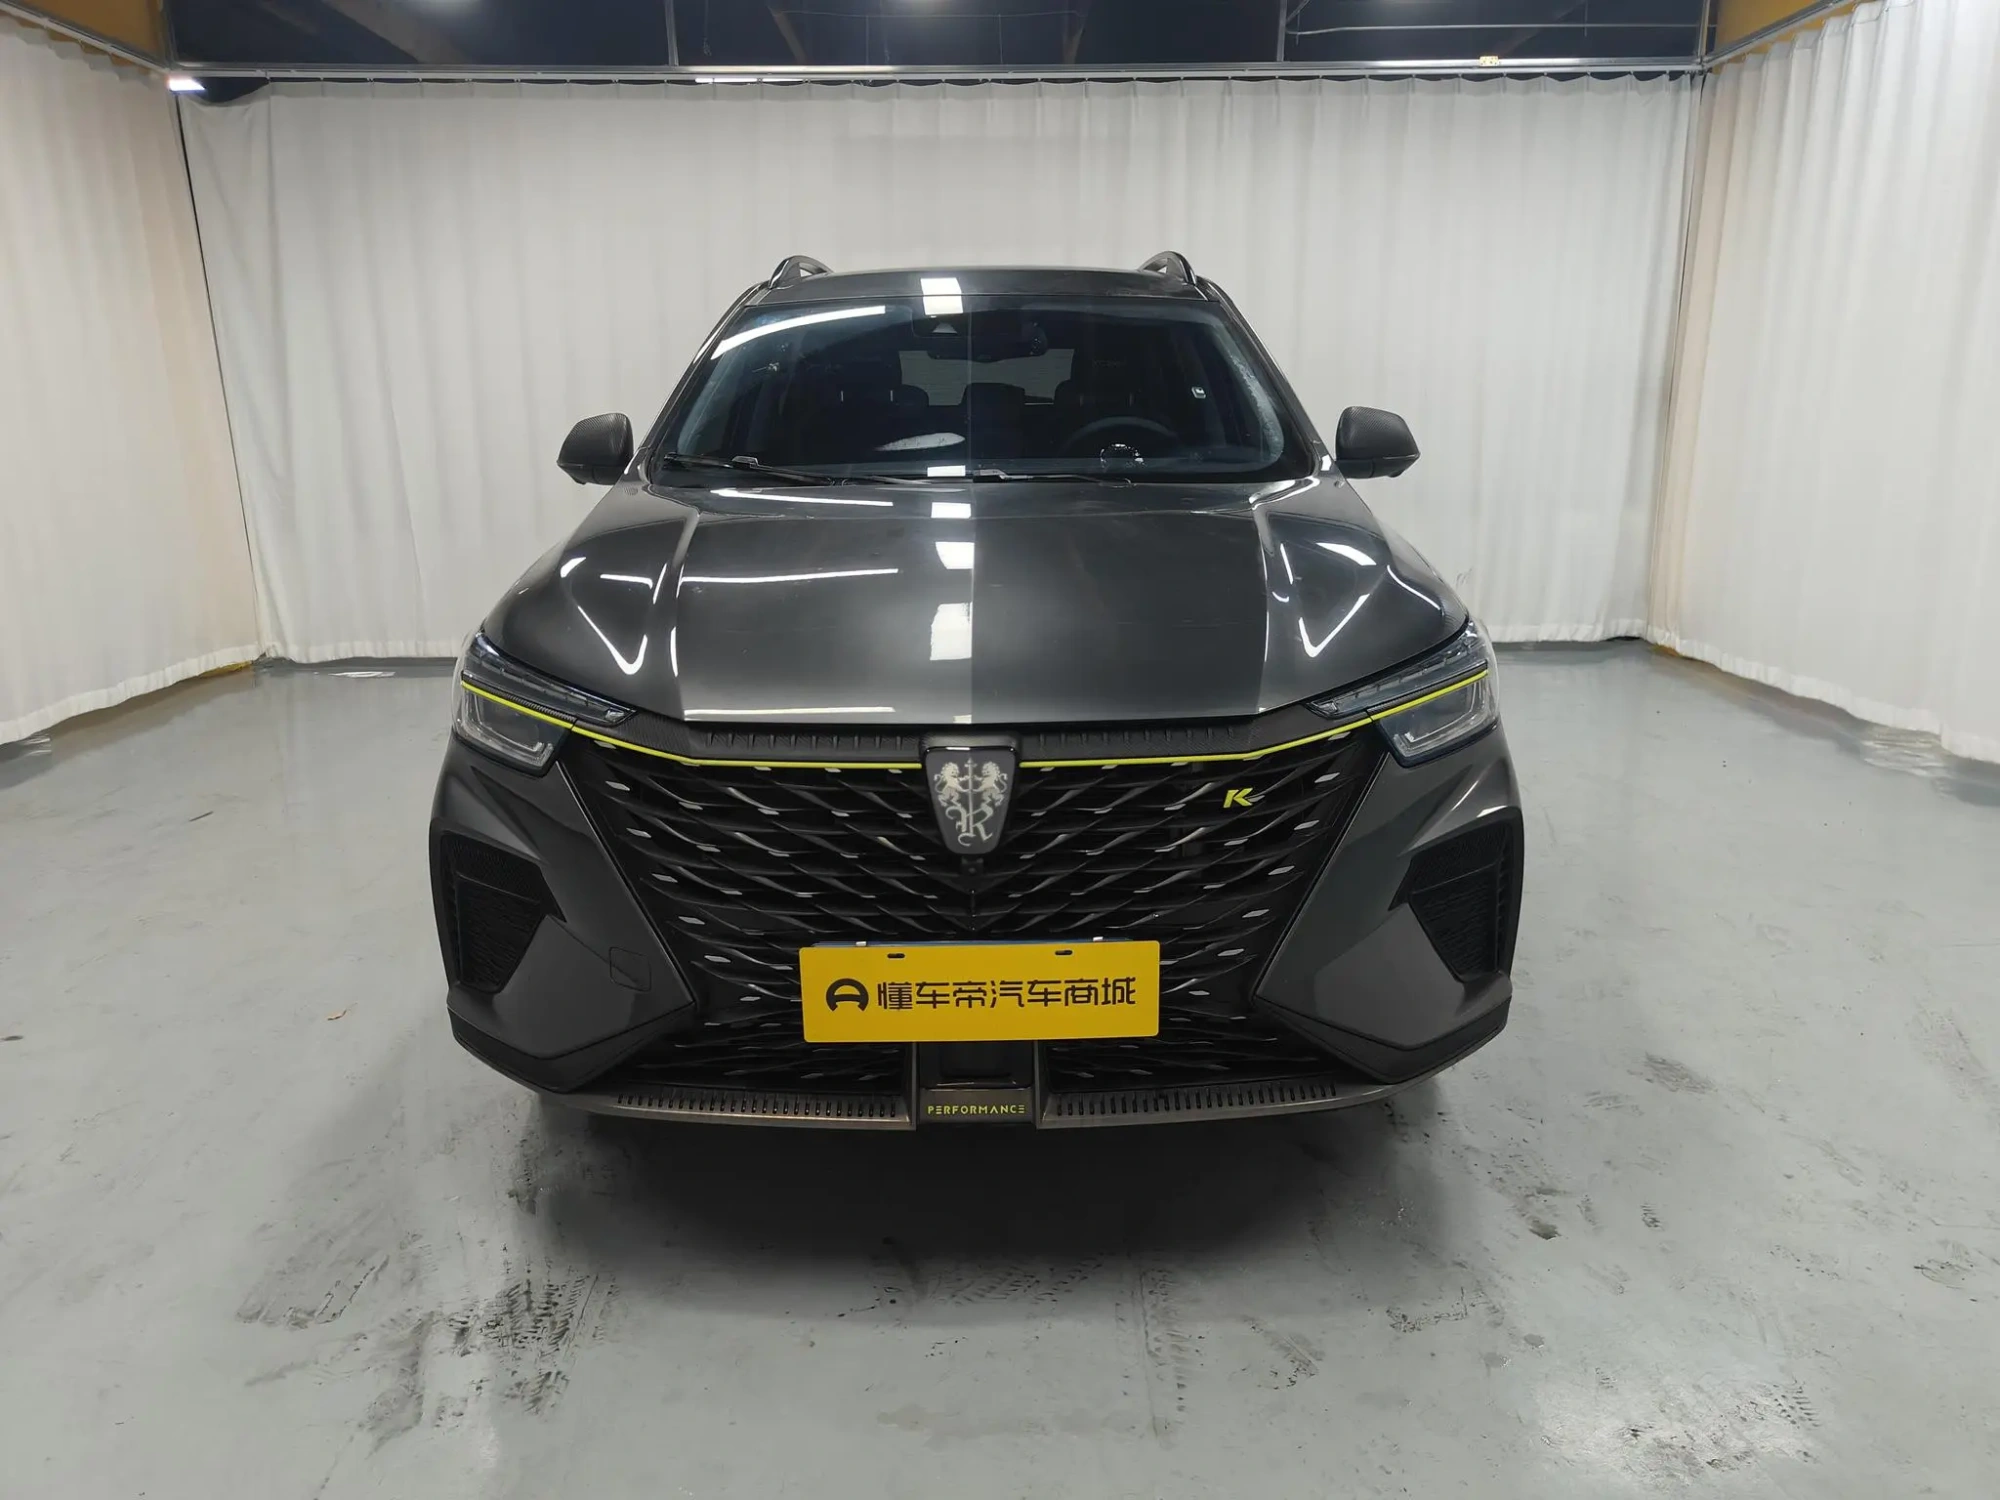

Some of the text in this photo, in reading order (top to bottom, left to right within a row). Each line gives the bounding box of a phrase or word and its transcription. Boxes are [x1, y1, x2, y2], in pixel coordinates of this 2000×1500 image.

[1223, 787, 1253, 808] K
[877, 976, 1136, 1011] 懂车帝汽车商城
[927, 1104, 1025, 1115] PERFORMANCE
